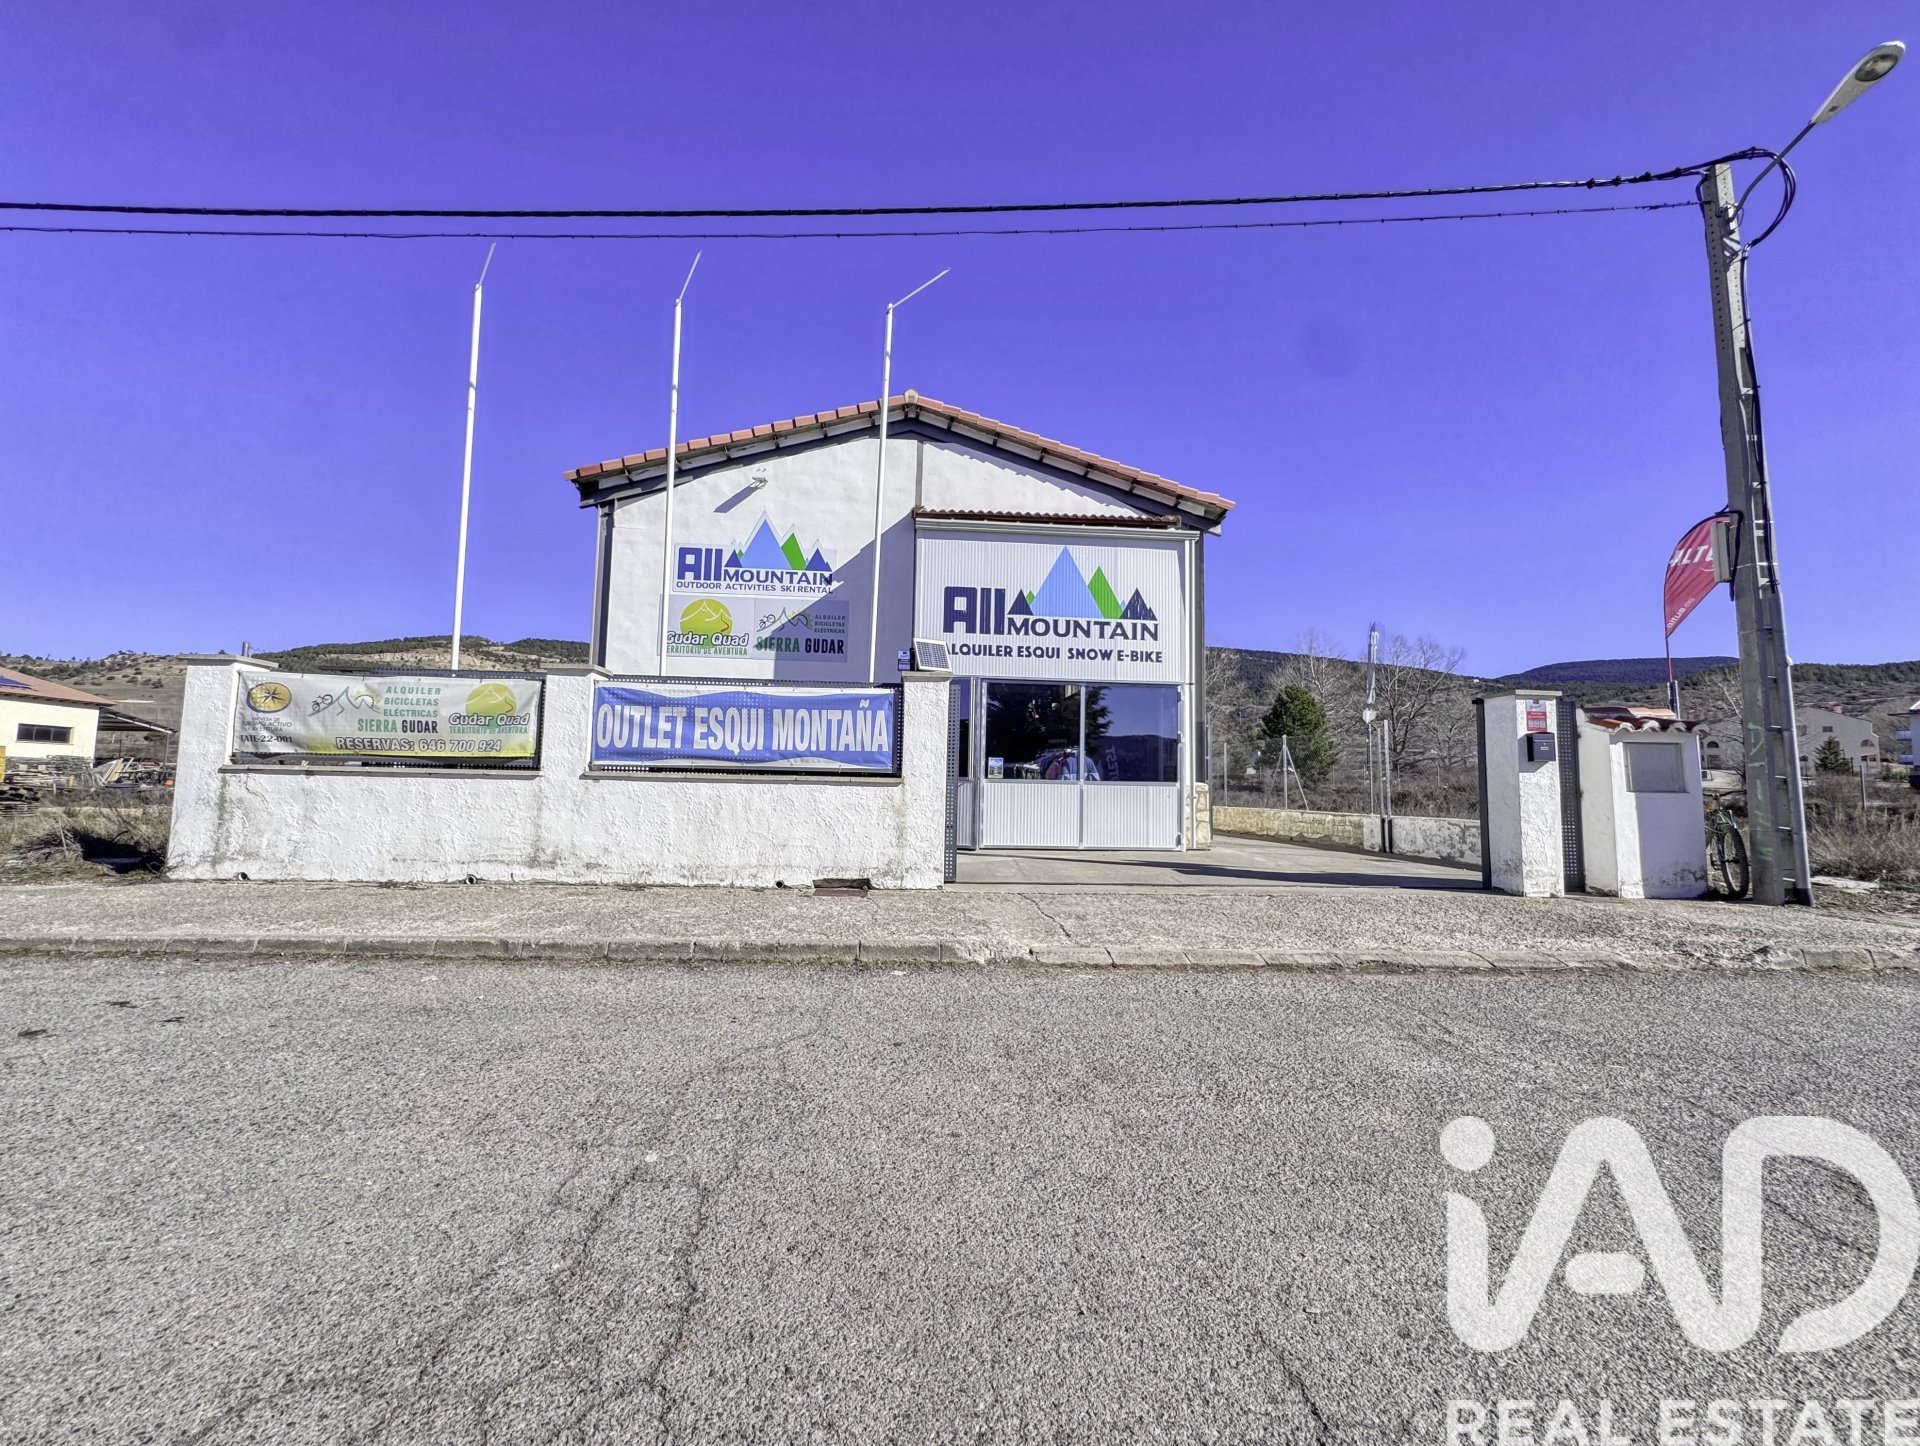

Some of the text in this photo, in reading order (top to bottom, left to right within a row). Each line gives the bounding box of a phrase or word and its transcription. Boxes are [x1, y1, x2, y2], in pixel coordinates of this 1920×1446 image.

[723, 568, 833, 586] MOUNTAIN
[676, 581, 833, 594] OUTDOOR ACTIVITIES SKI RENTAL
[1007, 617, 1159, 641] MOUNTAIN
[667, 631, 749, 646] Gudar Quad
[756, 636, 845, 654] SIERRA GUDAR
[666, 645, 748, 656] ERRITORIO DE AVENTURA
[1017, 645, 1061, 659] ESQUI
[1067, 647, 1114, 661] SNOW
[1117, 649, 1162, 663] E-BIKE
[385, 686, 442, 695] ALQUILER
[384, 697, 440, 706] BICICLETAS
[383, 707, 439, 718] ELÉCTRICAS
[449, 712, 530, 726] Gudar Quad
[357, 718, 439, 734] SIERRA GUDAR
[449, 726, 487, 735] TERRITORIO
[597, 699, 889, 755] OUTLET ESQUI MONTAÑA
[336, 736, 502, 752] RESERVAS: 646 700 924
